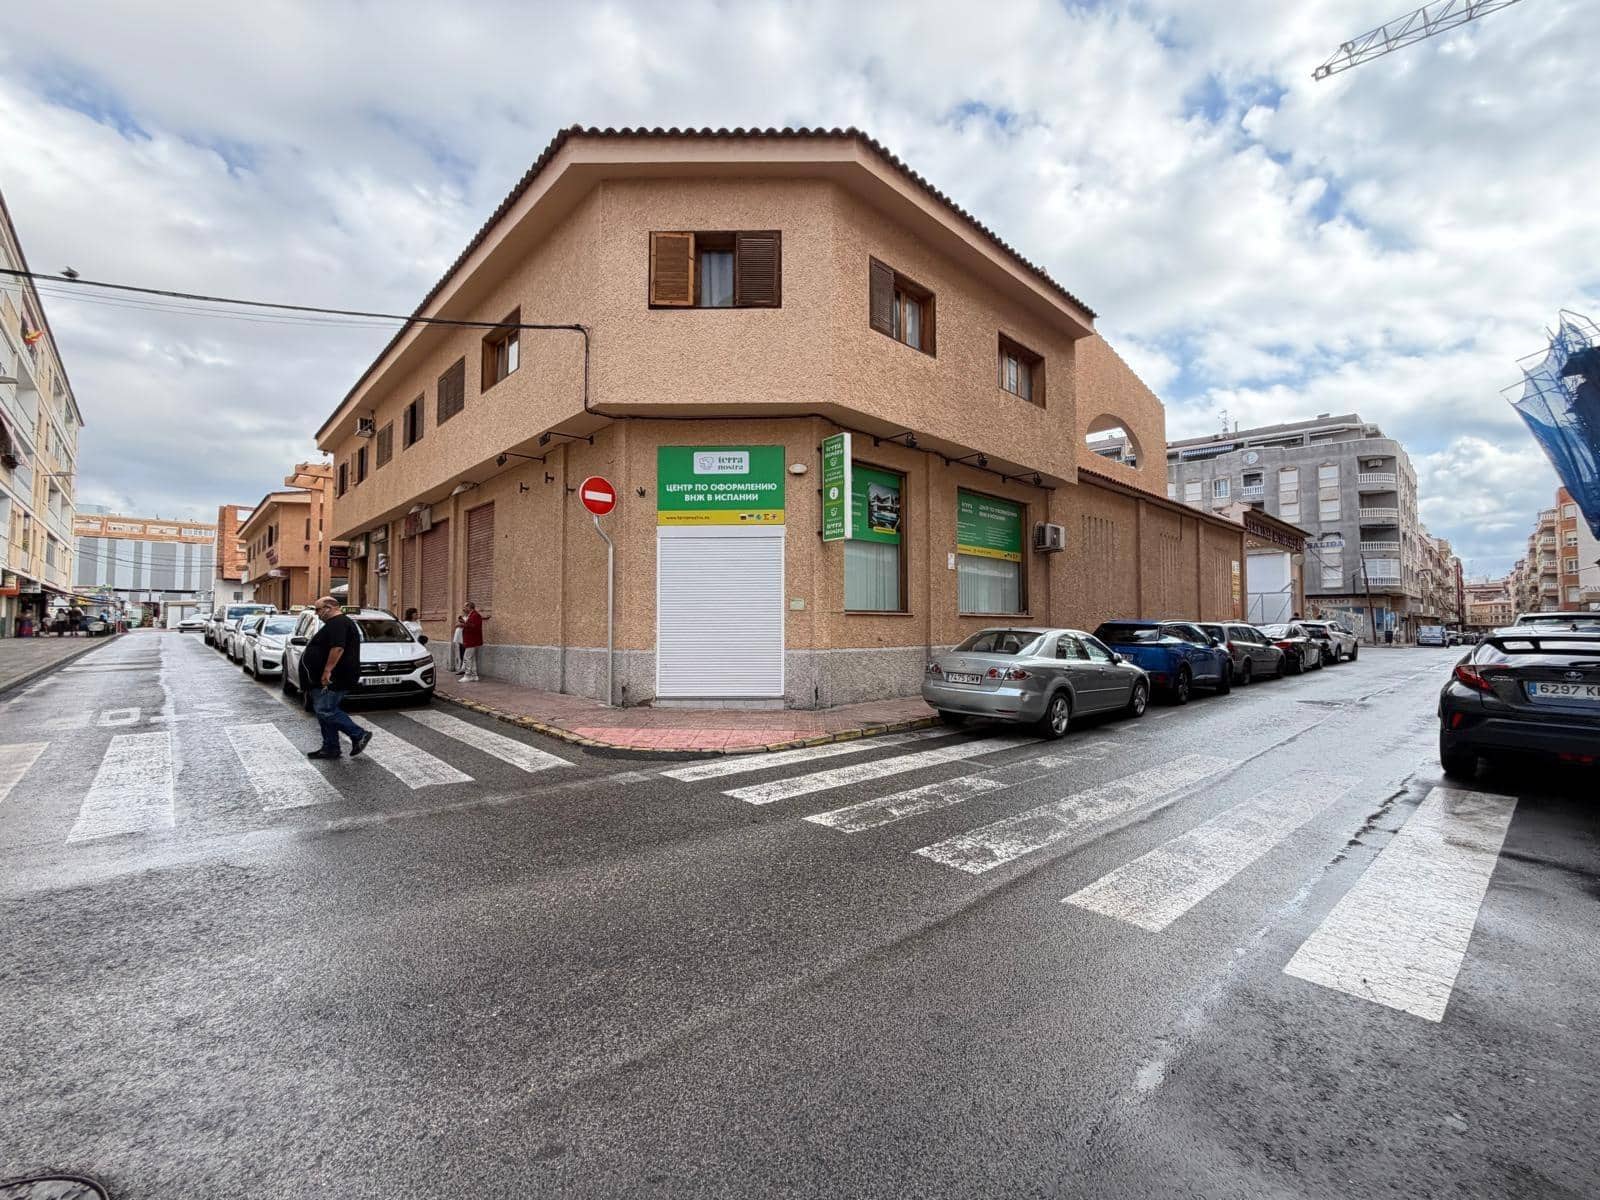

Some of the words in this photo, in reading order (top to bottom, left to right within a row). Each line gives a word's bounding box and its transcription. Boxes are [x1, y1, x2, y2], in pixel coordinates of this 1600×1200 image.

[666, 484, 693, 492] ЦЕНТР
[710, 483, 777, 491] ОФОРМЛЕНИЮ
[685, 494, 705, 502] ВНЖ
[715, 493, 759, 501] ИСПАНИИ
[1306, 540, 1344, 549] SALIDA
[1540, 684, 1580, 695] 6297
[1586, 686, 1600, 697] K
